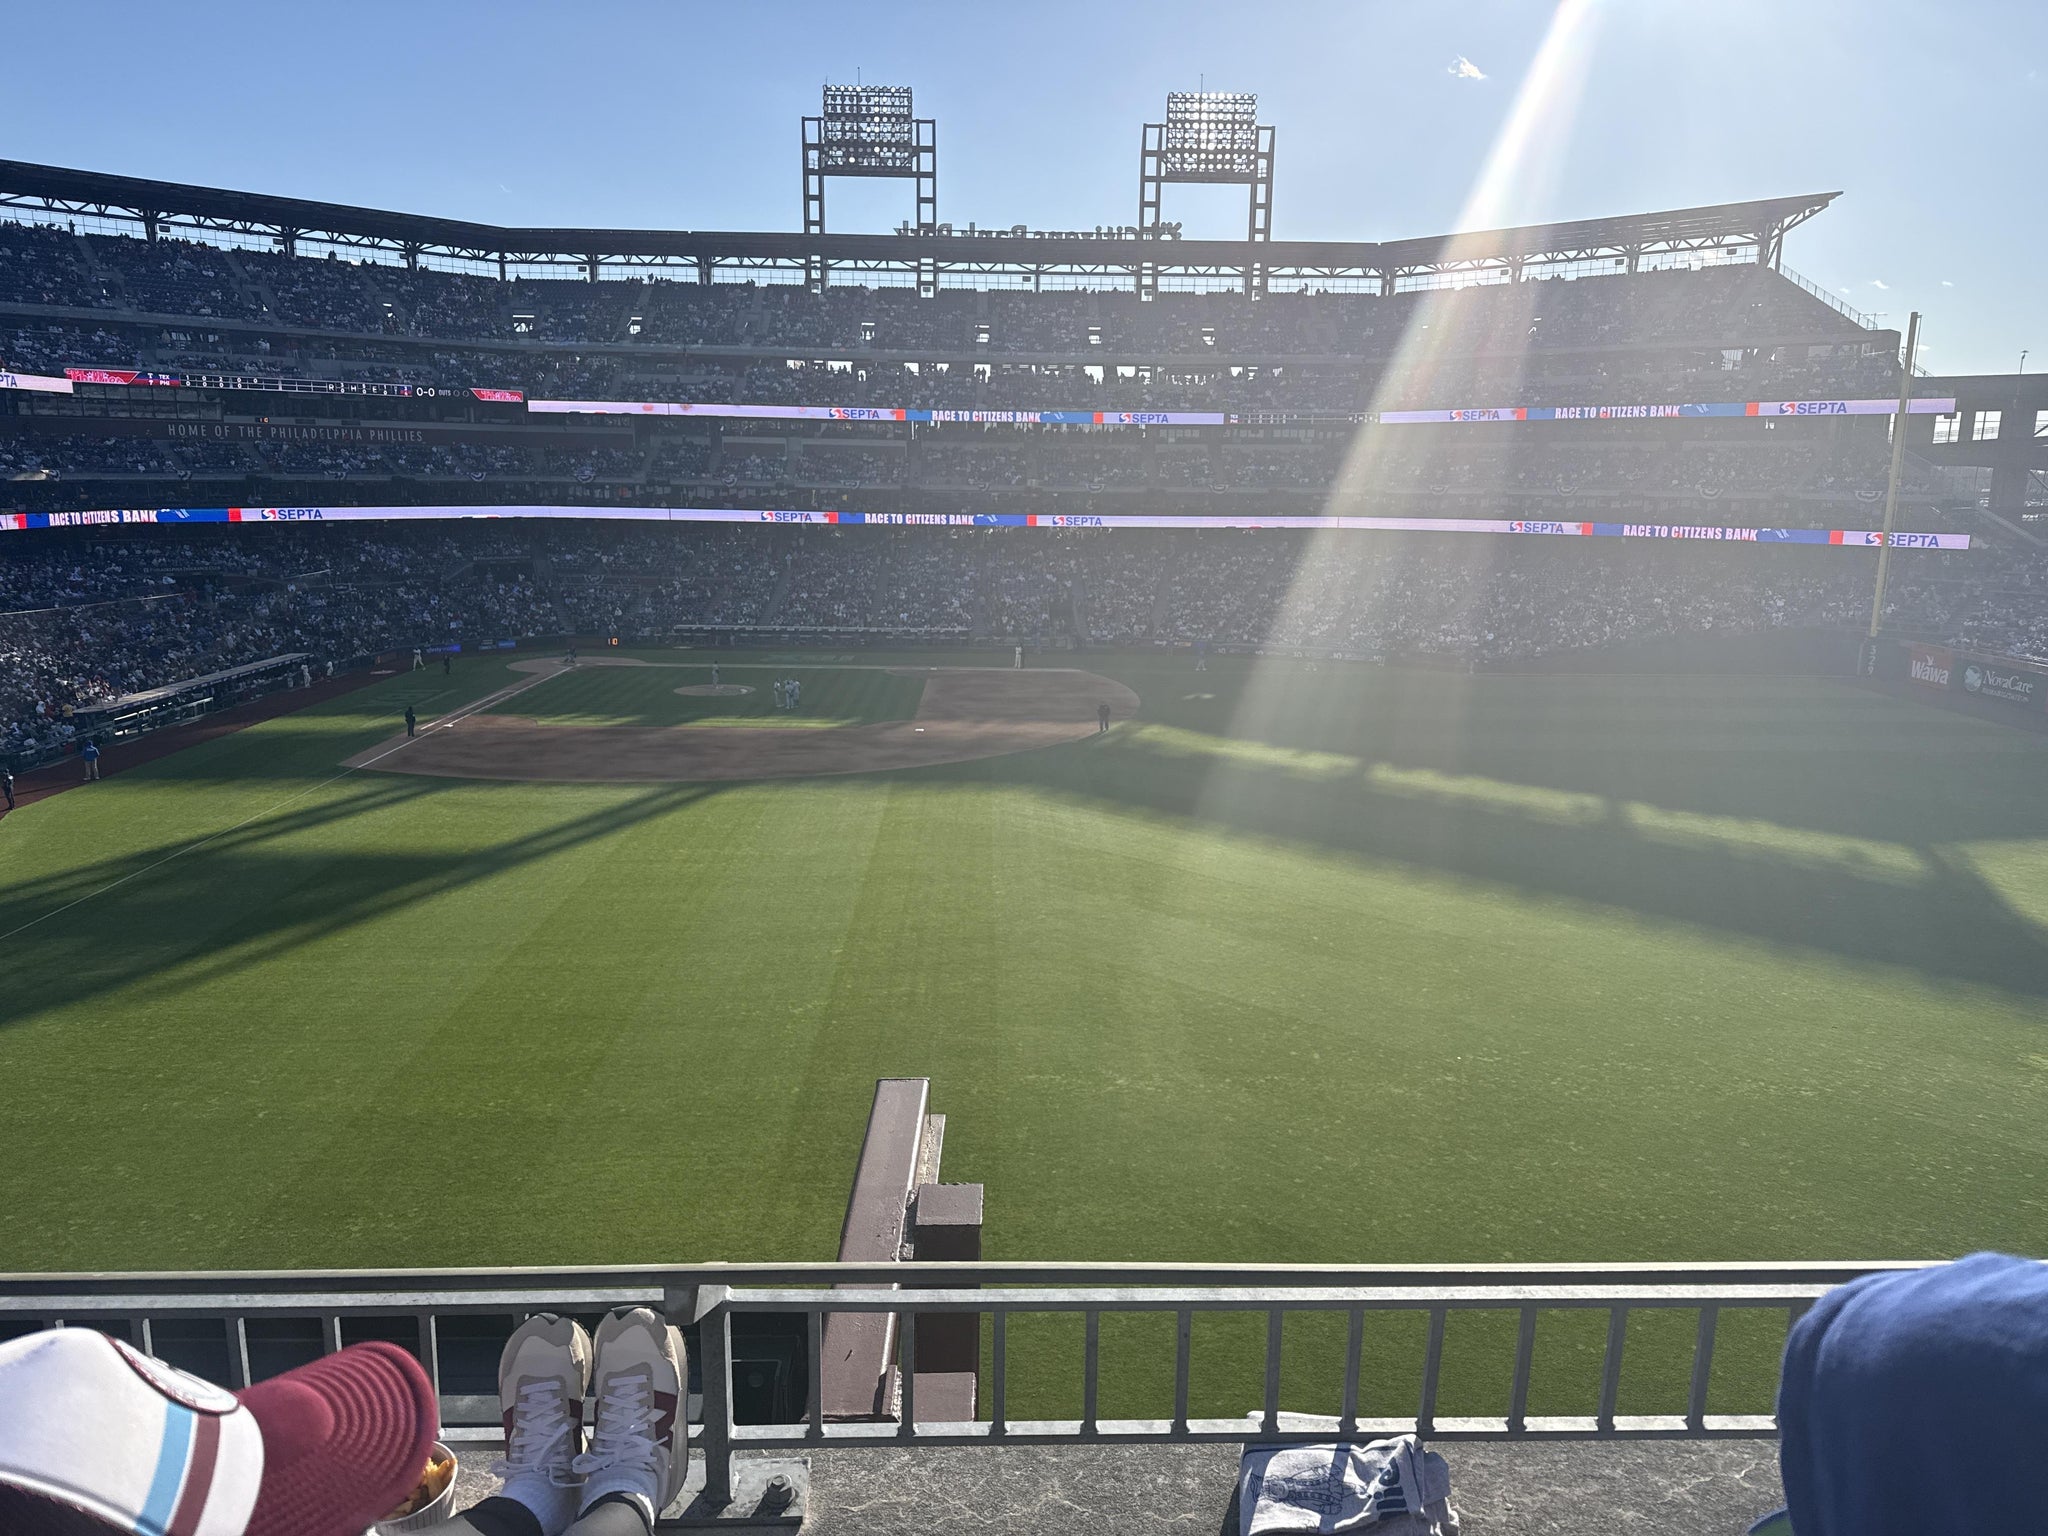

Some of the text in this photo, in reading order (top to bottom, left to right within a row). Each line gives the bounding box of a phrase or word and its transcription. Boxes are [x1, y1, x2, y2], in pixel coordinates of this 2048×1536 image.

[416, 387, 435, 397] 0-0
[842, 408, 879, 419] SEPTA
[1554, 404, 1681, 419] RACE TO CITIZENS BANK
[1796, 402, 1847, 414] SEPTA
[931, 410, 1041, 423] RACE TO CITIZENS BANK
[1131, 413, 1168, 424] SEPTA
[1462, 409, 1500, 421] SEPTA
[168, 424, 423, 442] HOME OF THE PHILADELPHIA PHILLIES
[48, 509, 158, 527] RACE TO CITIZENS BANK
[278, 509, 323, 520] SEPTA
[774, 511, 812, 522] SEPTA
[864, 512, 974, 525] RACE TO CITIZENS BANK
[1065, 516, 1102, 526] SEPTA
[1523, 522, 1564, 534] SEPTA
[1622, 524, 1758, 541] RACE TO CITIZENS BANK
[1885, 532, 1939, 548] SEPTA
[1911, 660, 1949, 685] Wawa
[1982, 669, 2034, 694] NovaCare
